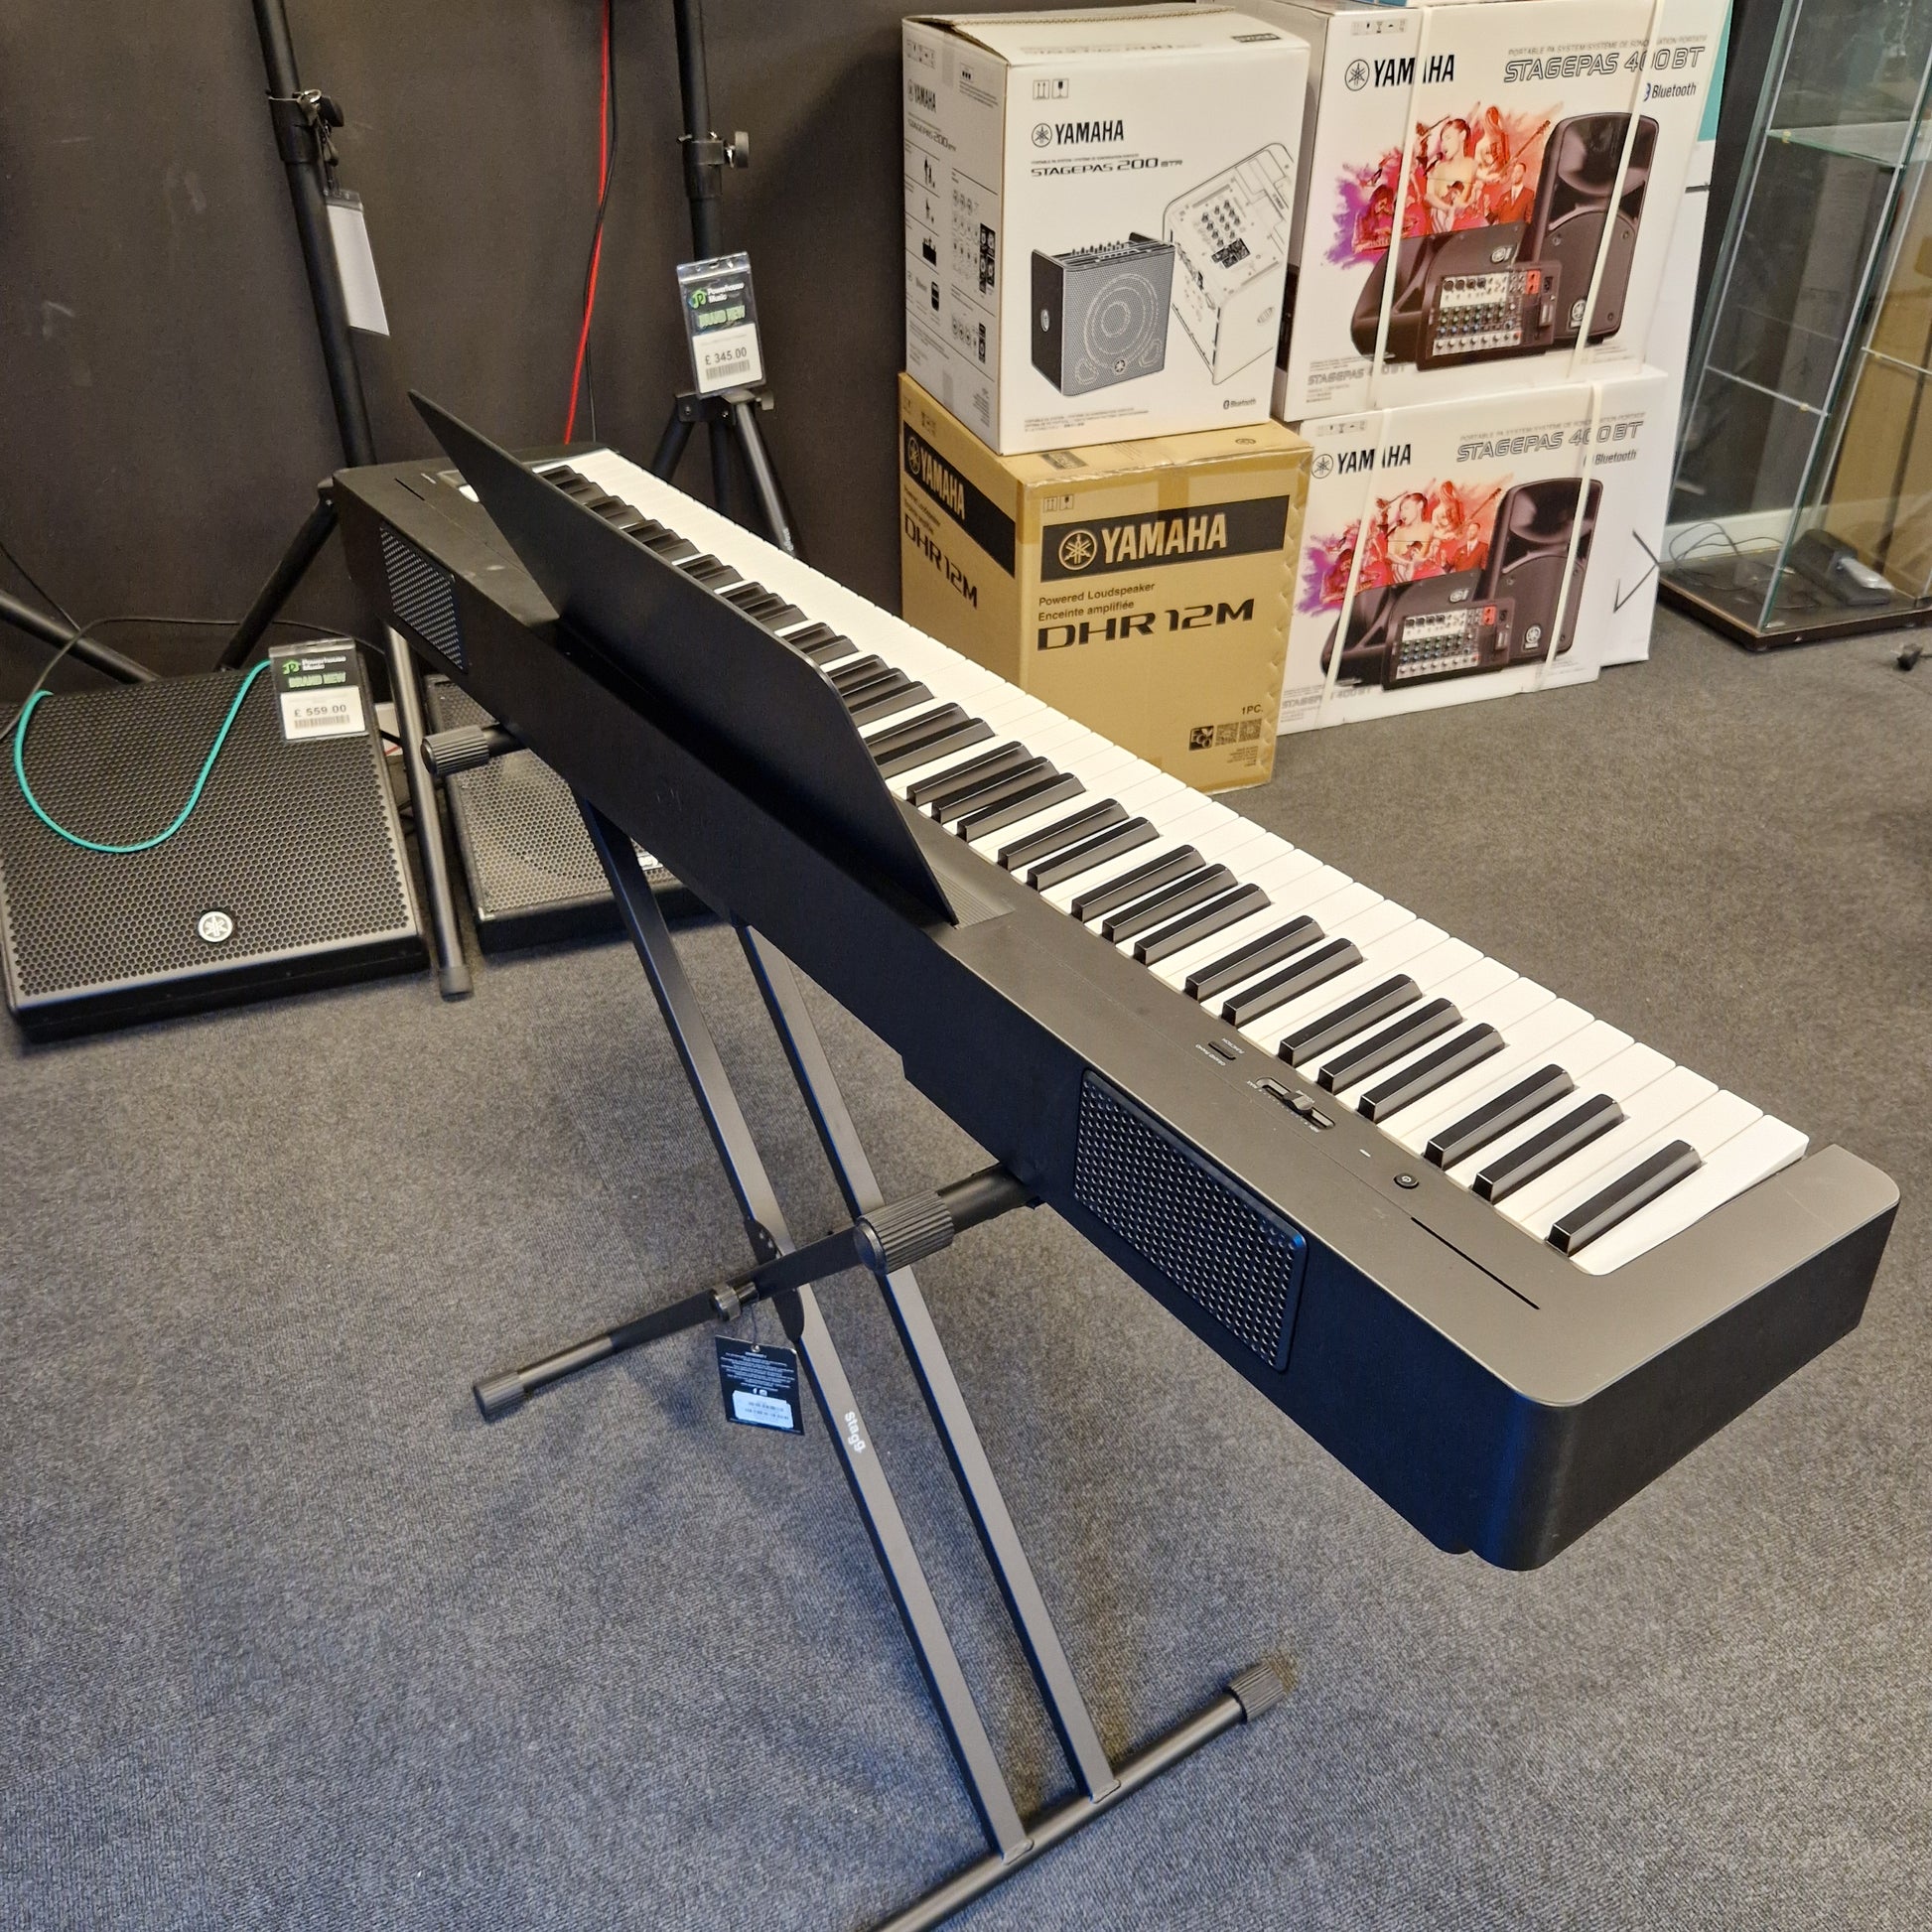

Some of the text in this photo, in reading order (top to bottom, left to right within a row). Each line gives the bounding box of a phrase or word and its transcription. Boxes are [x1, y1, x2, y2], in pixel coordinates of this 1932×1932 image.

[1504, 52, 1620, 82] STAGEPAS
[913, 82, 937, 113] YAMAHA
[1651, 81, 1697, 99] Bluetooth
[1054, 119, 1124, 145] YAMAHA
[1031, 163, 1114, 177] STAGEPAS
[1117, 157, 1159, 171] 200
[705, 346, 748, 365] £ 345.00
[1456, 431, 1565, 463] STAGEPAS
[1594, 449, 1637, 466] Bluetooth
[919, 446, 966, 520] YAMAHA
[1100, 512, 1227, 564] YAMAHA
[1038, 582, 1156, 607] Powered Loudspeaker
[1038, 600, 1135, 621] Enceinte amplifiée
[323, 671, 346, 685] NEW
[844, 1410, 867, 1453] stagg
